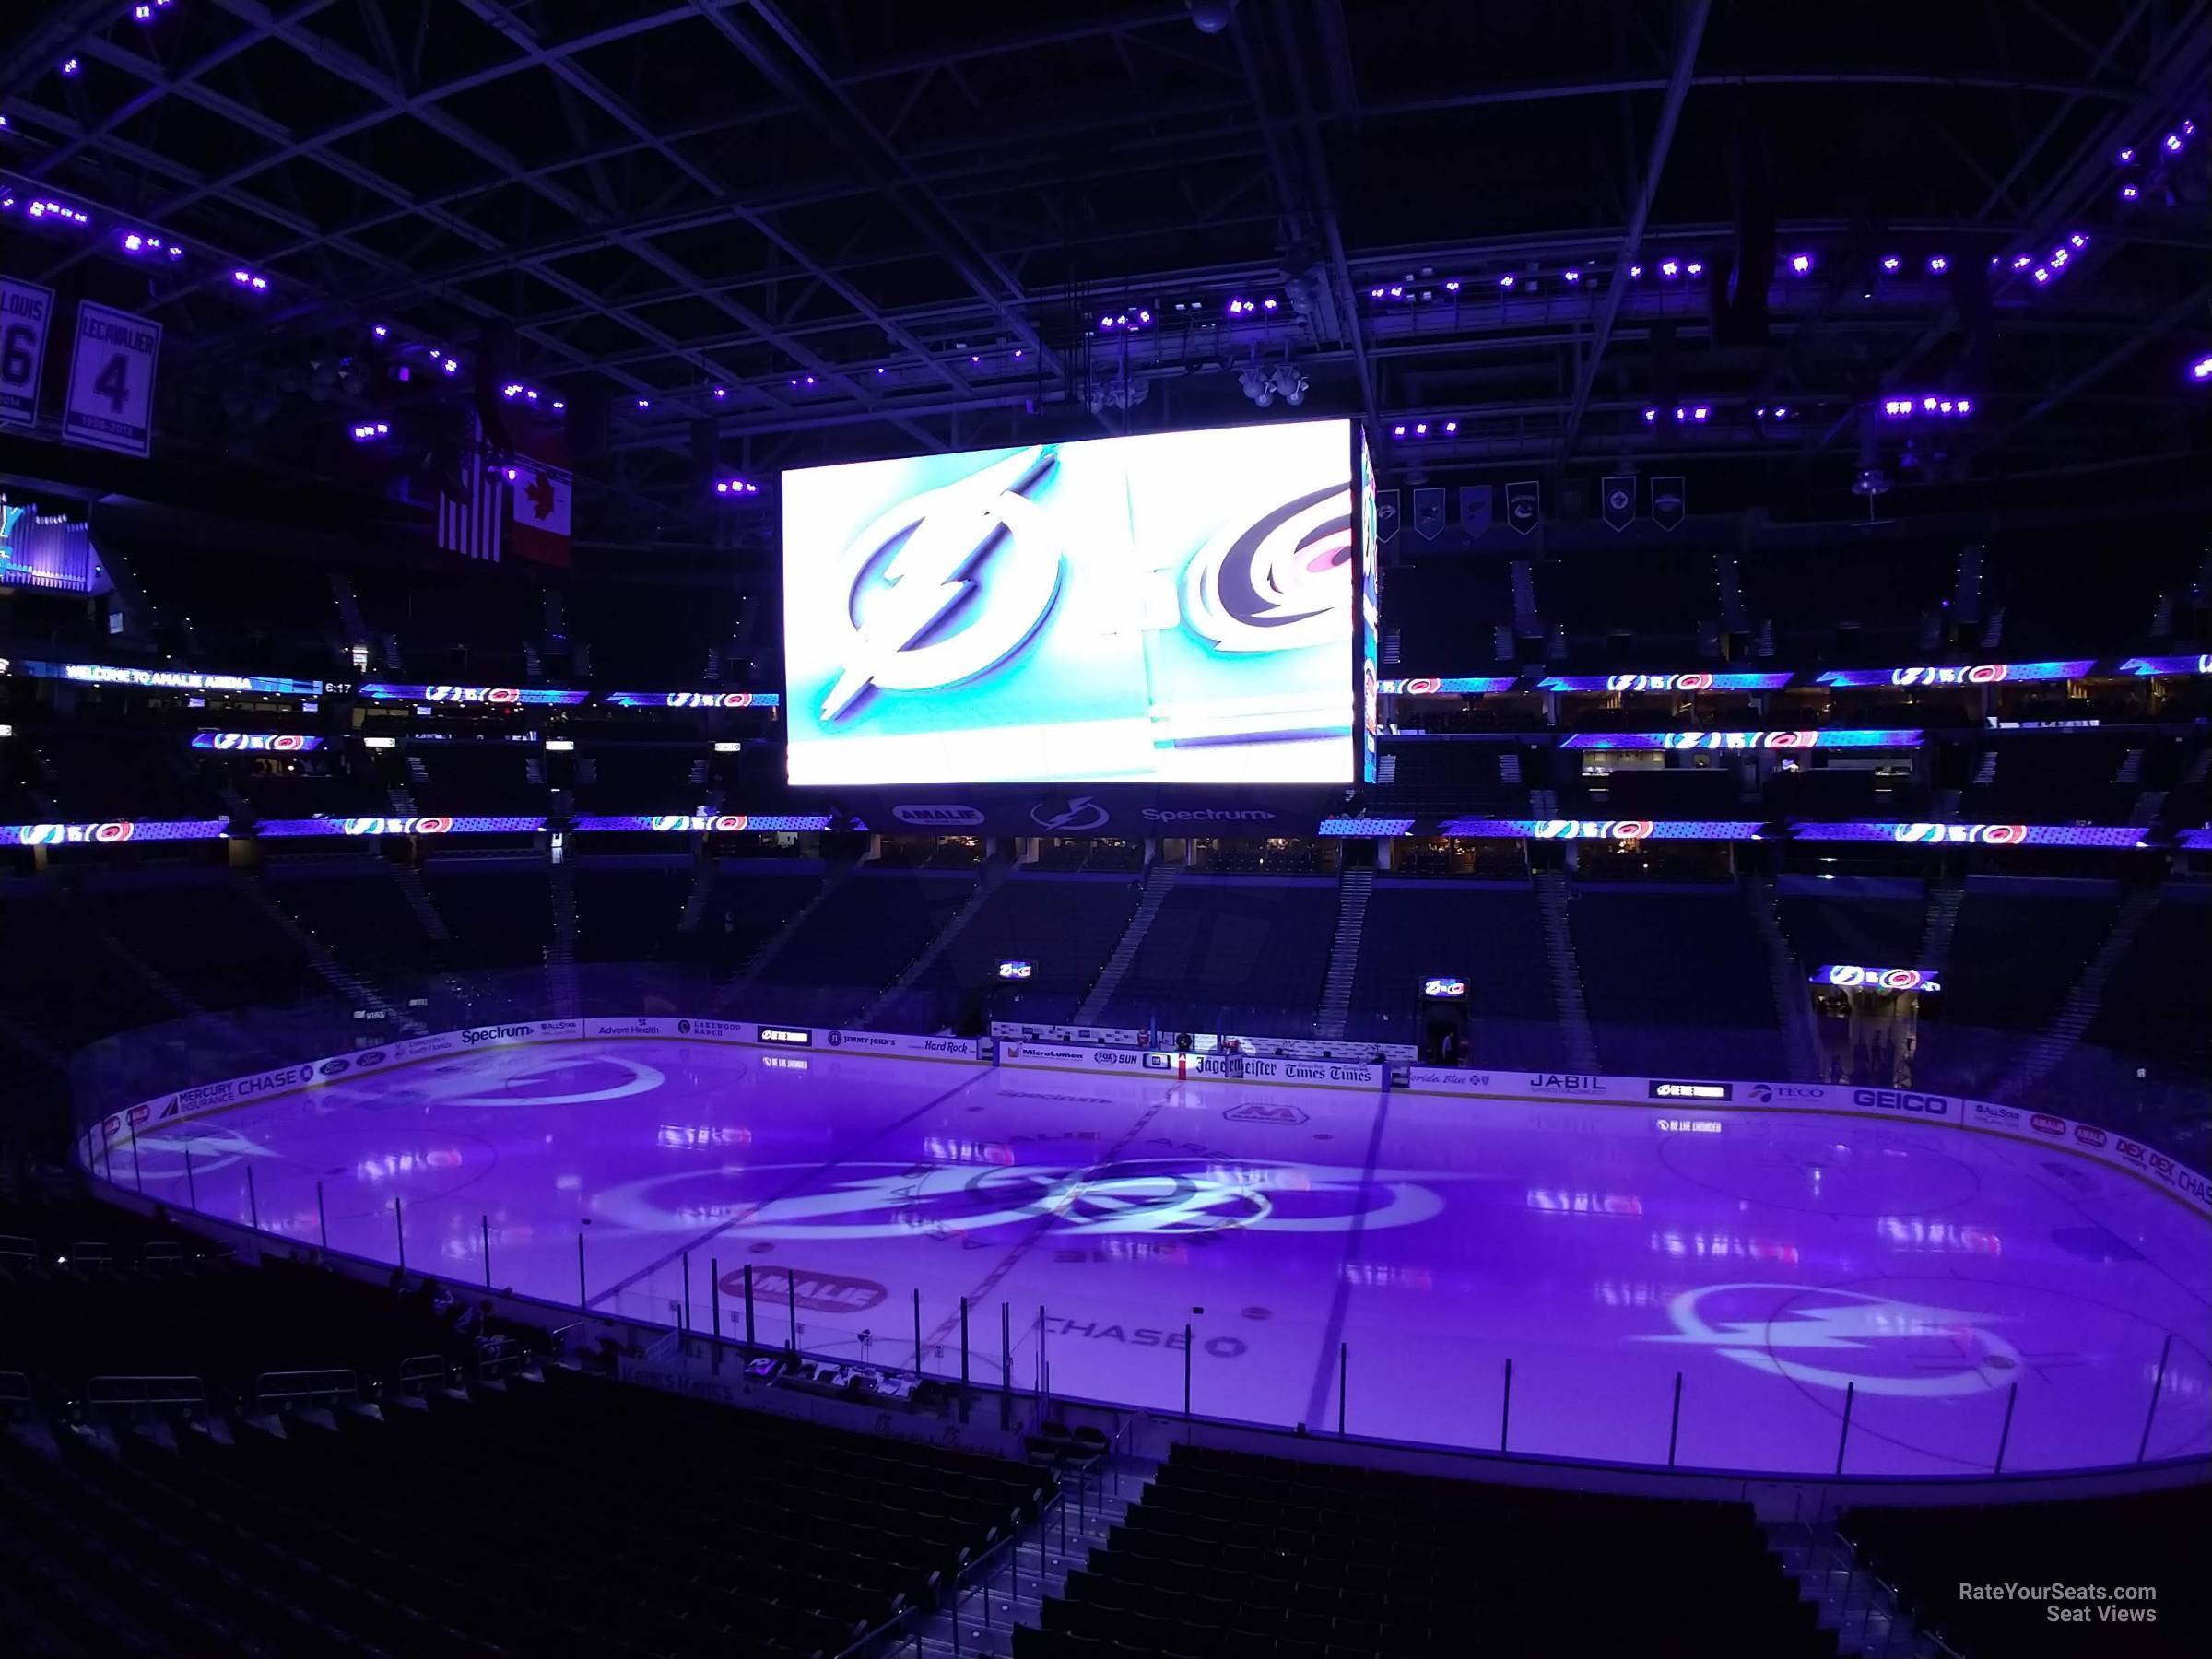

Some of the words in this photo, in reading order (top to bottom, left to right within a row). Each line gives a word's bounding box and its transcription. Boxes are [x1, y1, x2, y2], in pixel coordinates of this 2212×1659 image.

[83, 316, 154, 354] LECAVALIER
[93, 353, 129, 415] 4
[66, 665, 129, 683] WELCOME
[131, 668, 149, 684] TO
[151, 671, 203, 688] AMALIE
[205, 675, 252, 689] ARENA
[902, 810, 979, 820] AMALIE
[1142, 808, 1268, 822] Spectrum
[461, 1024, 530, 1045] Spectrum
[693, 1021, 741, 1031] LAKEWOOD
[843, 1035, 868, 1044] JIMMY
[924, 1039, 946, 1052] Hard
[947, 1041, 968, 1054] Rock
[1118, 1054, 1137, 1064] SUN
[1285, 1064, 1325, 1078] Times
[1330, 1065, 1371, 1081] Times
[1410, 1073, 1441, 1083] orida
[1530, 1074, 1606, 1089] JABIL
[180, 1082, 233, 1103] MERCURY
[238, 1070, 297, 1096] CHASE
[1775, 1087, 1824, 1098] TECO
[1853, 1089, 1947, 1115] GEICO
[2116, 1138, 2147, 1161] DEX
[2149, 1153, 2175, 1177] DEX
[1032, 1316, 1194, 1350] CHASE
